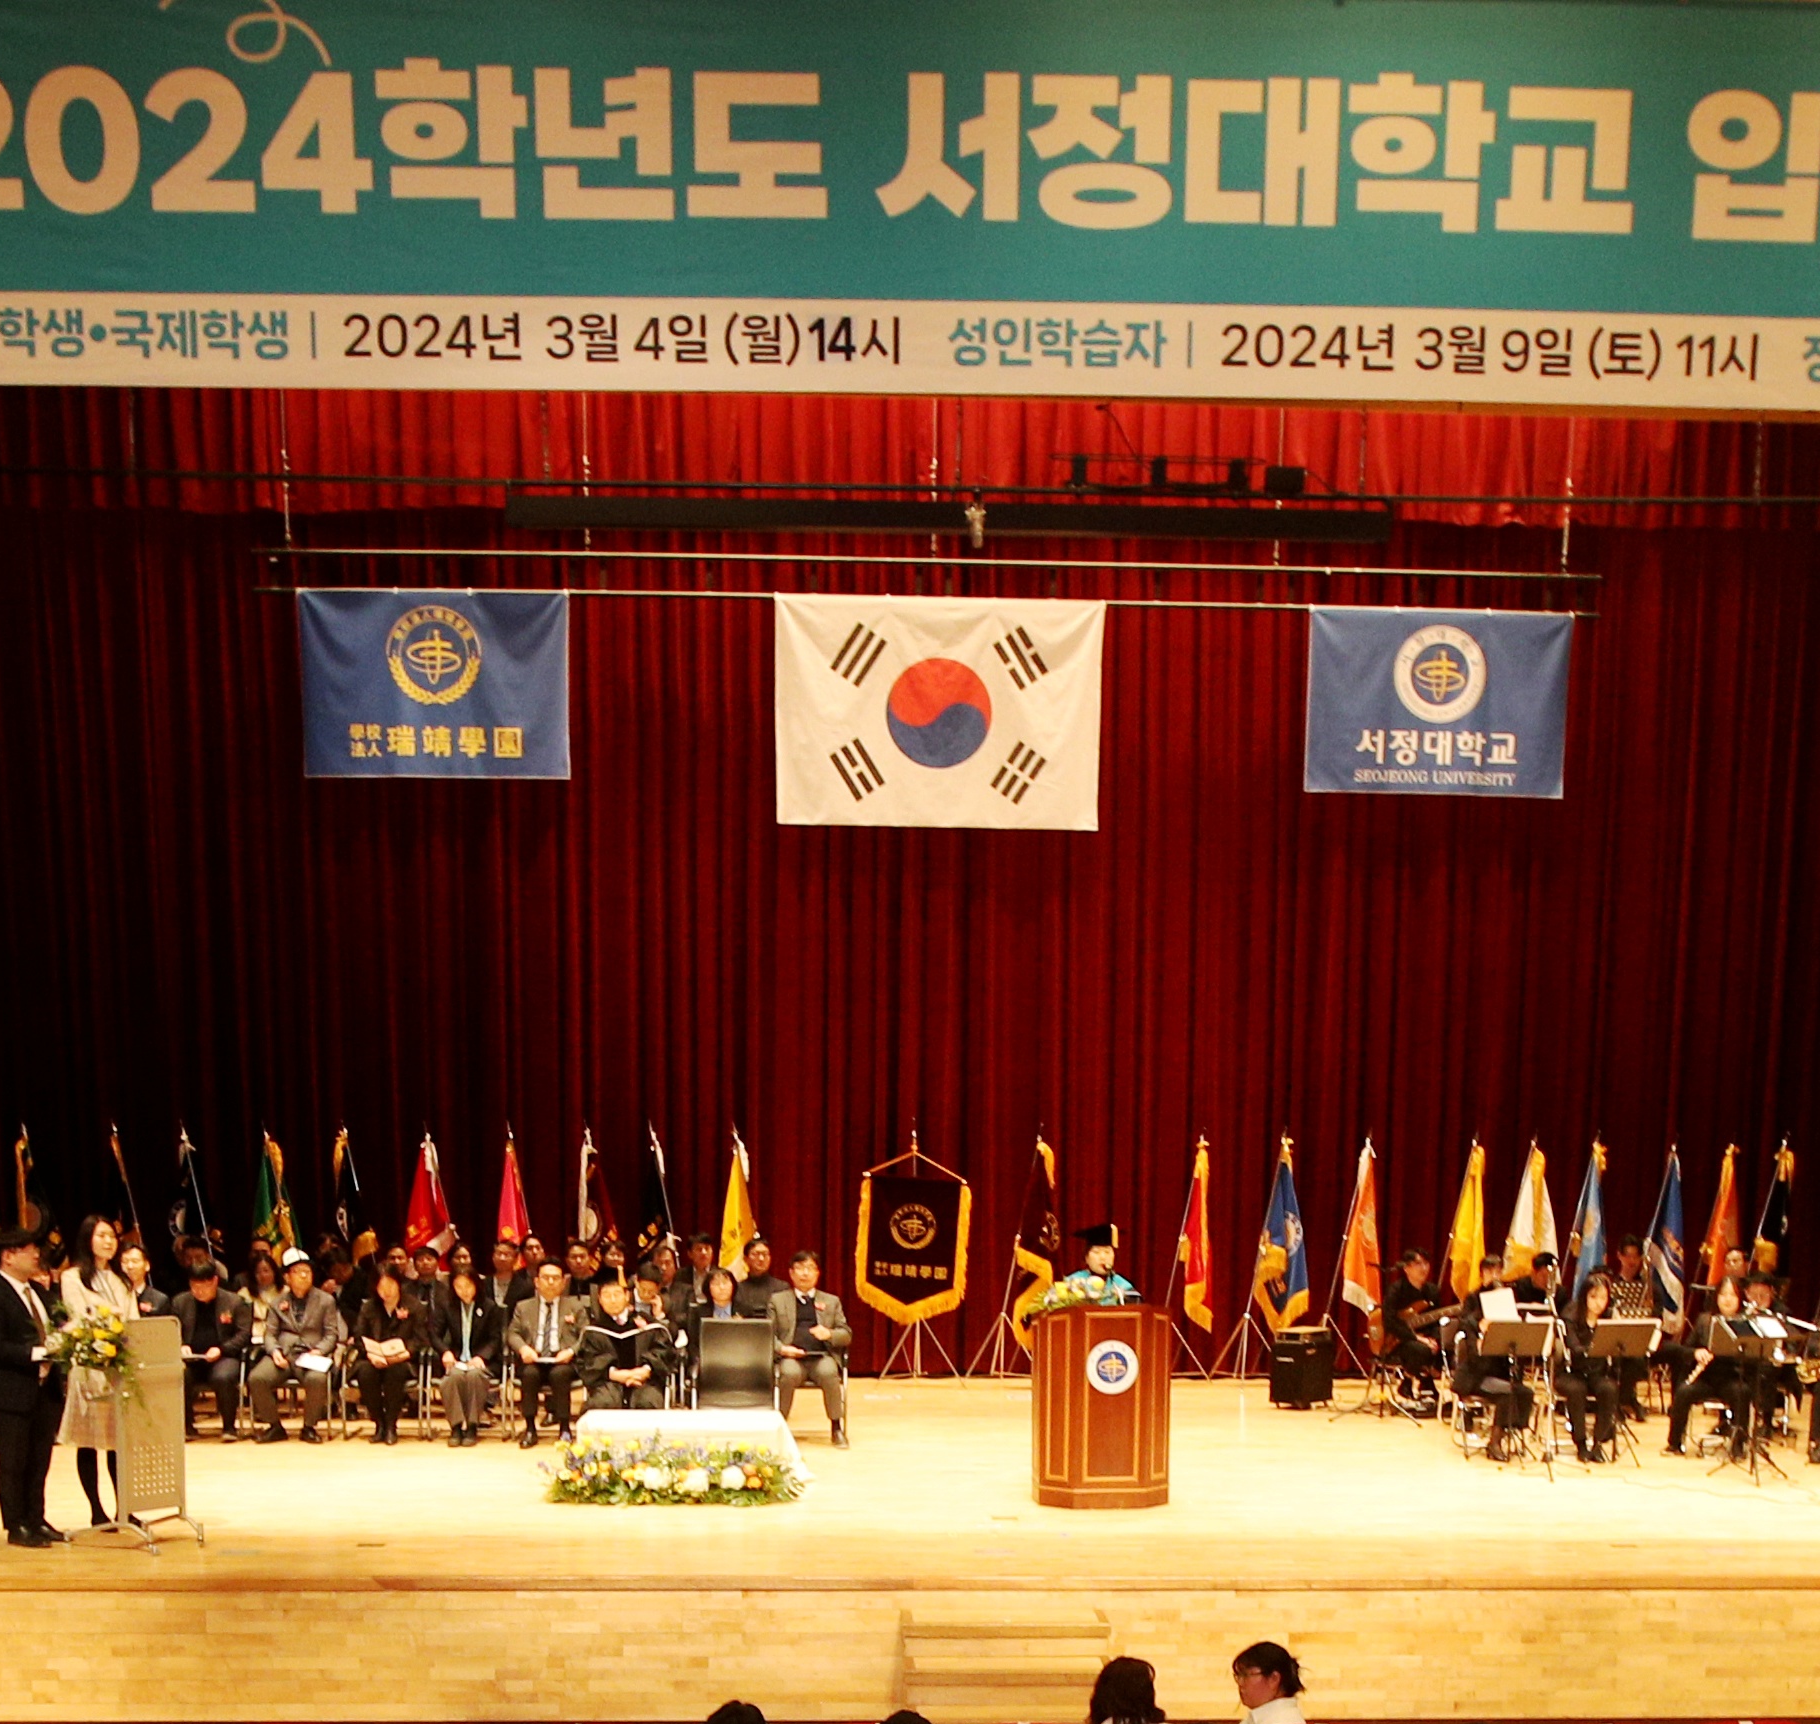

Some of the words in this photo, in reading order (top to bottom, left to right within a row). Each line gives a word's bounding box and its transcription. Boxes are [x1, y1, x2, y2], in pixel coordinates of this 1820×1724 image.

[876, 72, 1633, 234] 서정대학교
[343, 311, 522, 361] 2024년
[545, 313, 620, 363] 3월
[633, 314, 709, 364] 4일
[948, 317, 1167, 368] 성인학습자
[1221, 323, 1395, 372] 2024년
[1415, 325, 1487, 375] 3월
[1501, 328, 1573, 376] 9일
[1676, 333, 1760, 381] 11시
[1355, 729, 1518, 766] 서정대학교
[1353, 769, 1428, 783] SEOJEONG
[1432, 770, 1517, 787] UNIVERSITY
